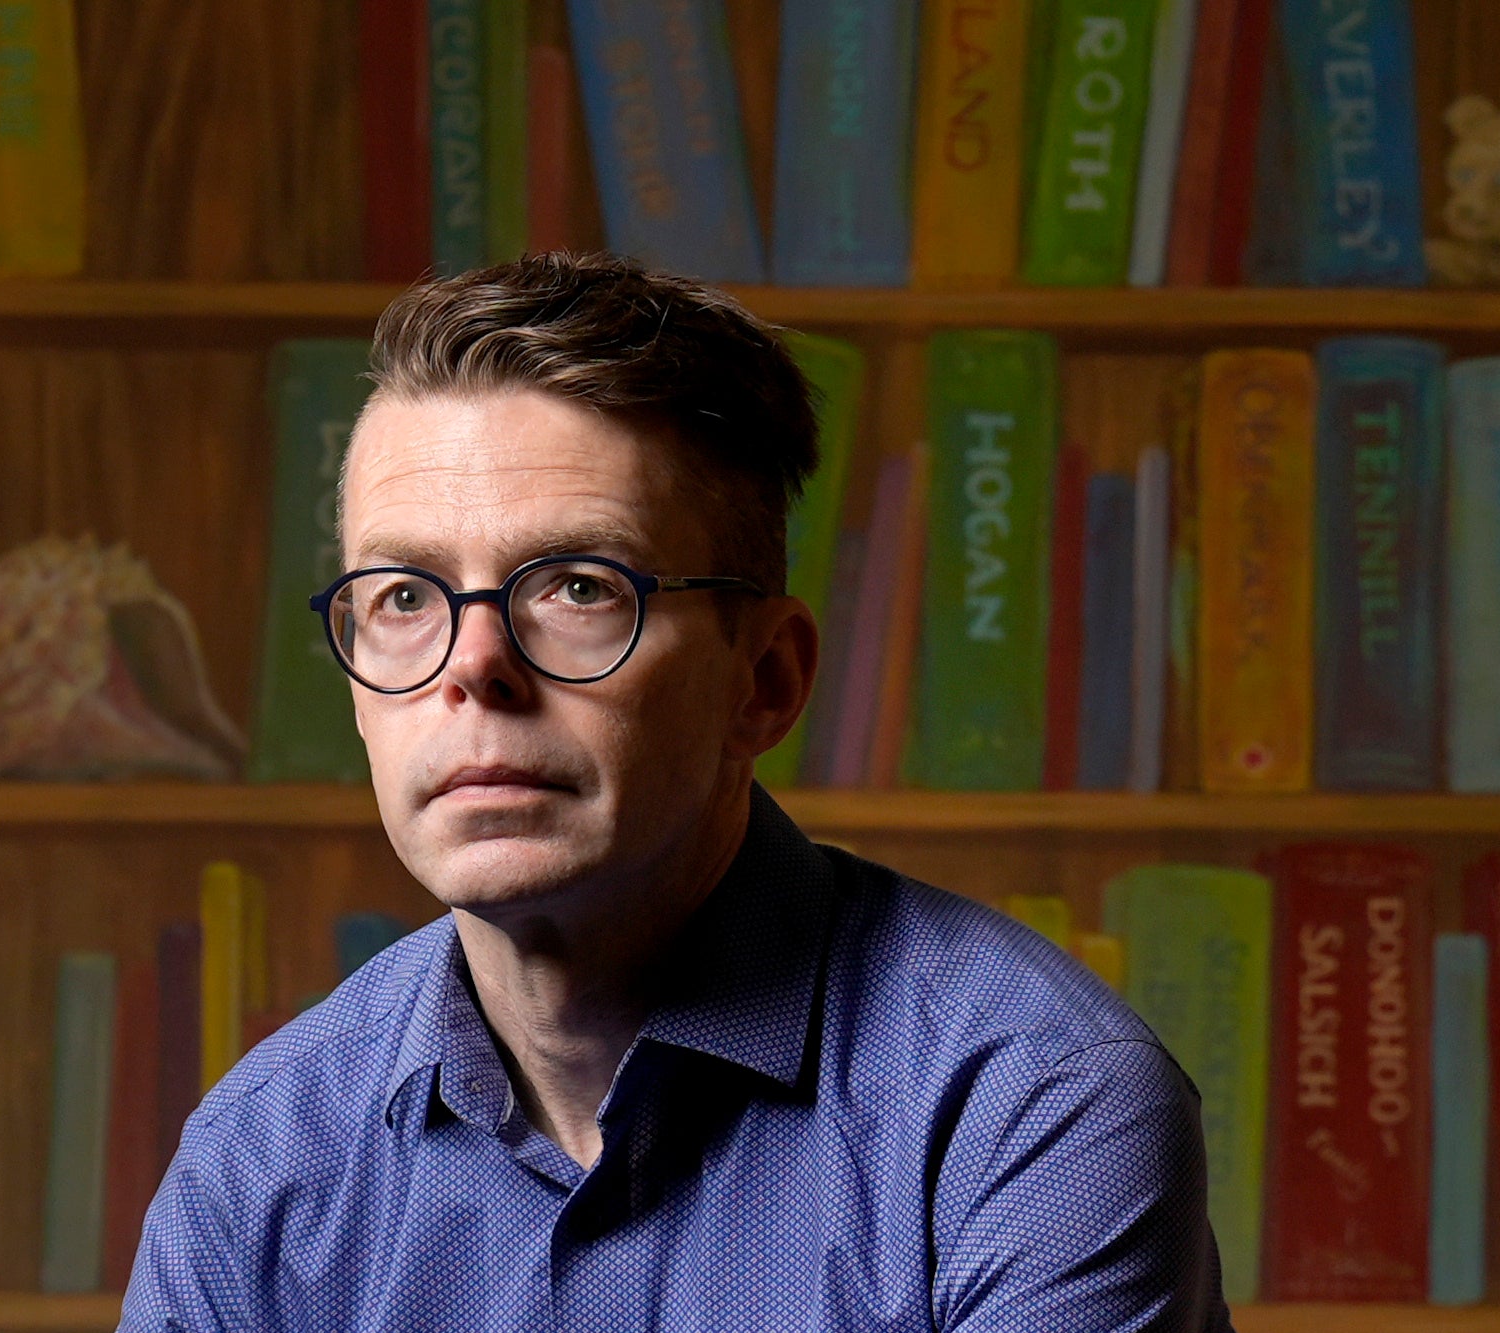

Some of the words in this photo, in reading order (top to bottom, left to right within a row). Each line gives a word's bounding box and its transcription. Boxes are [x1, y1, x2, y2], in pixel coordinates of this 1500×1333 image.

[1064, 14, 1125, 217] ROTH
[1320, 0, 1401, 263] VERLEY
[962, 410, 1016, 646] HOGAN
[1298, 922, 1346, 1112] SALSICH
